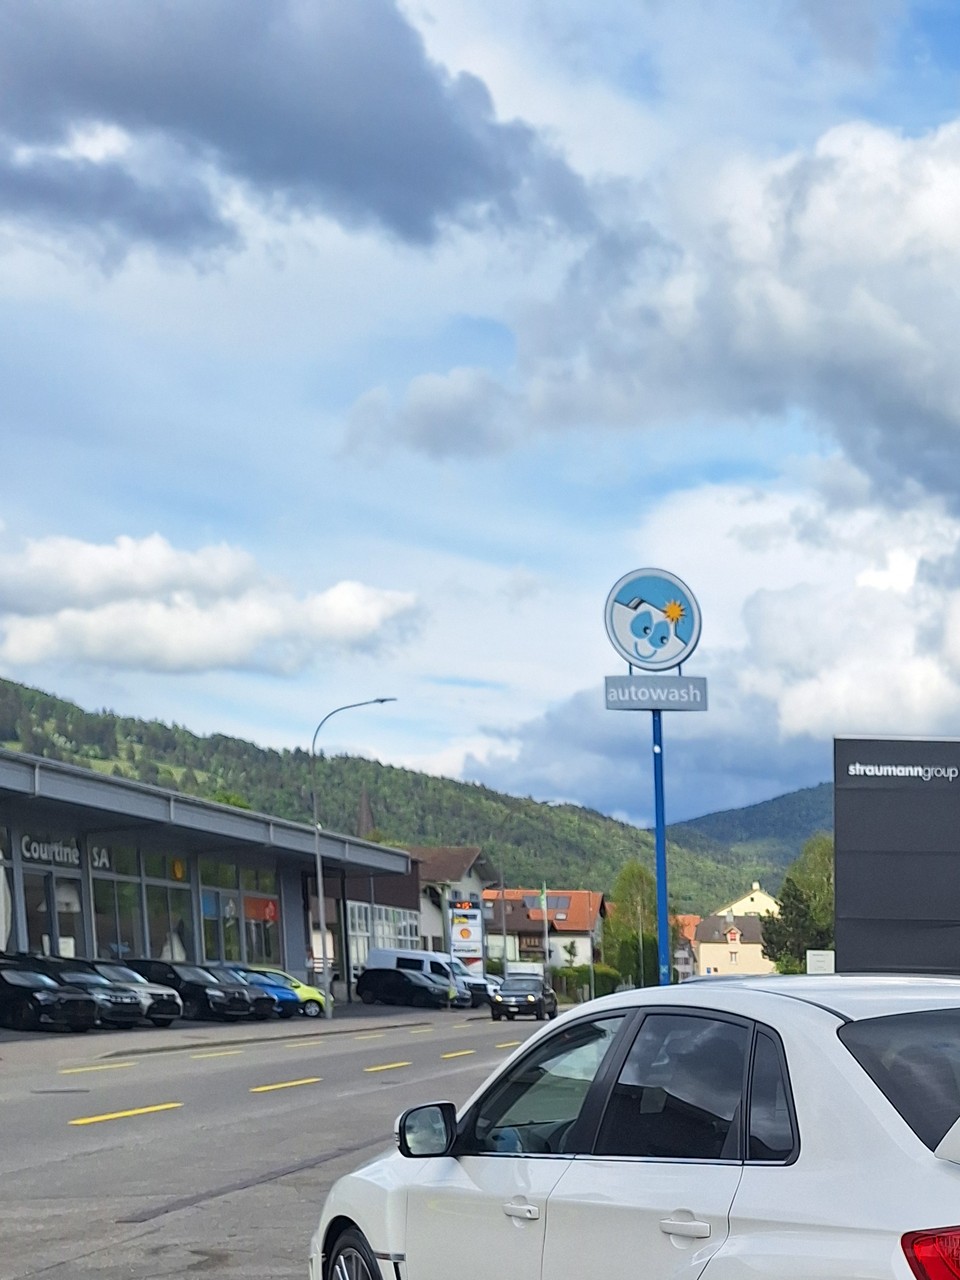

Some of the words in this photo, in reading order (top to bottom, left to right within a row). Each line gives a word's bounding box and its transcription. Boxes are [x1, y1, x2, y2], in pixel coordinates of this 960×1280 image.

[608, 684, 701, 702] autowash
[848, 761, 959, 781] straumanngroup
[21, 835, 80, 864] Courtine
[92, 846, 110, 868] SA
